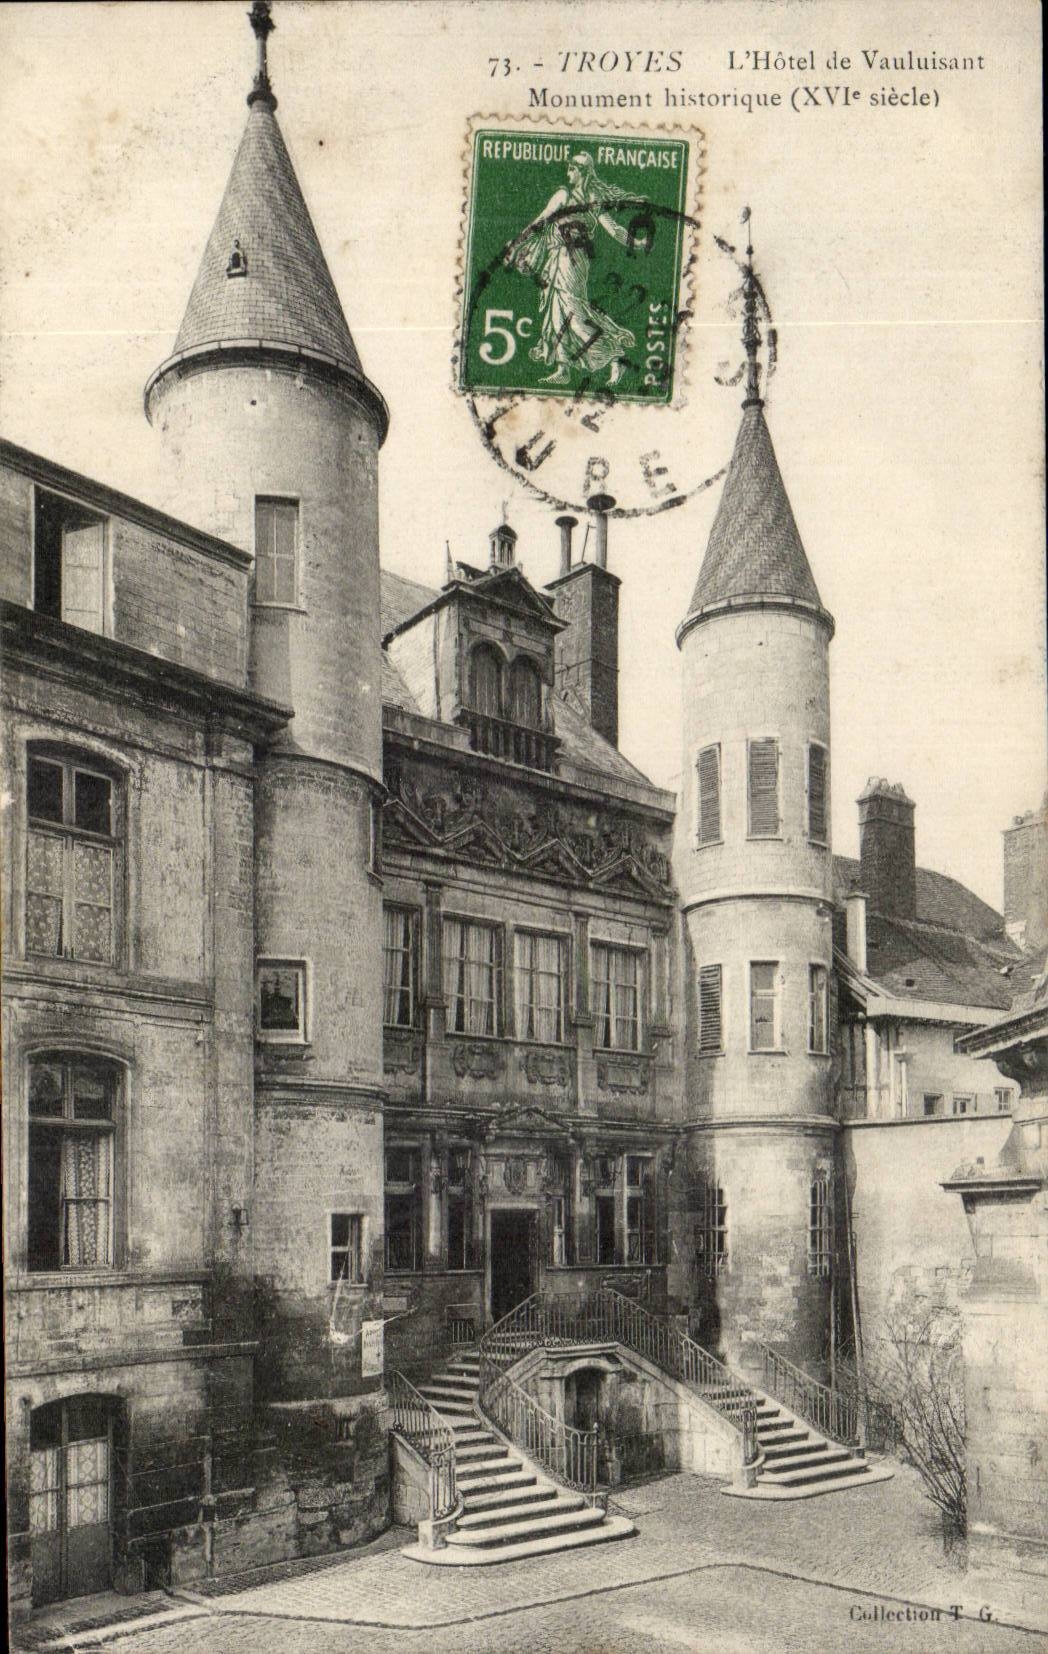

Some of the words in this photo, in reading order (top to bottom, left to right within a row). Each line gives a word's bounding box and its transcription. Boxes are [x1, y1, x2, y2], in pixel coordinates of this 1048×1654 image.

[483, 139, 571, 165] REPUBLIQUE
[597, 145, 679, 170] FRANÇAISE
[644, 302, 668, 387] POSTES
